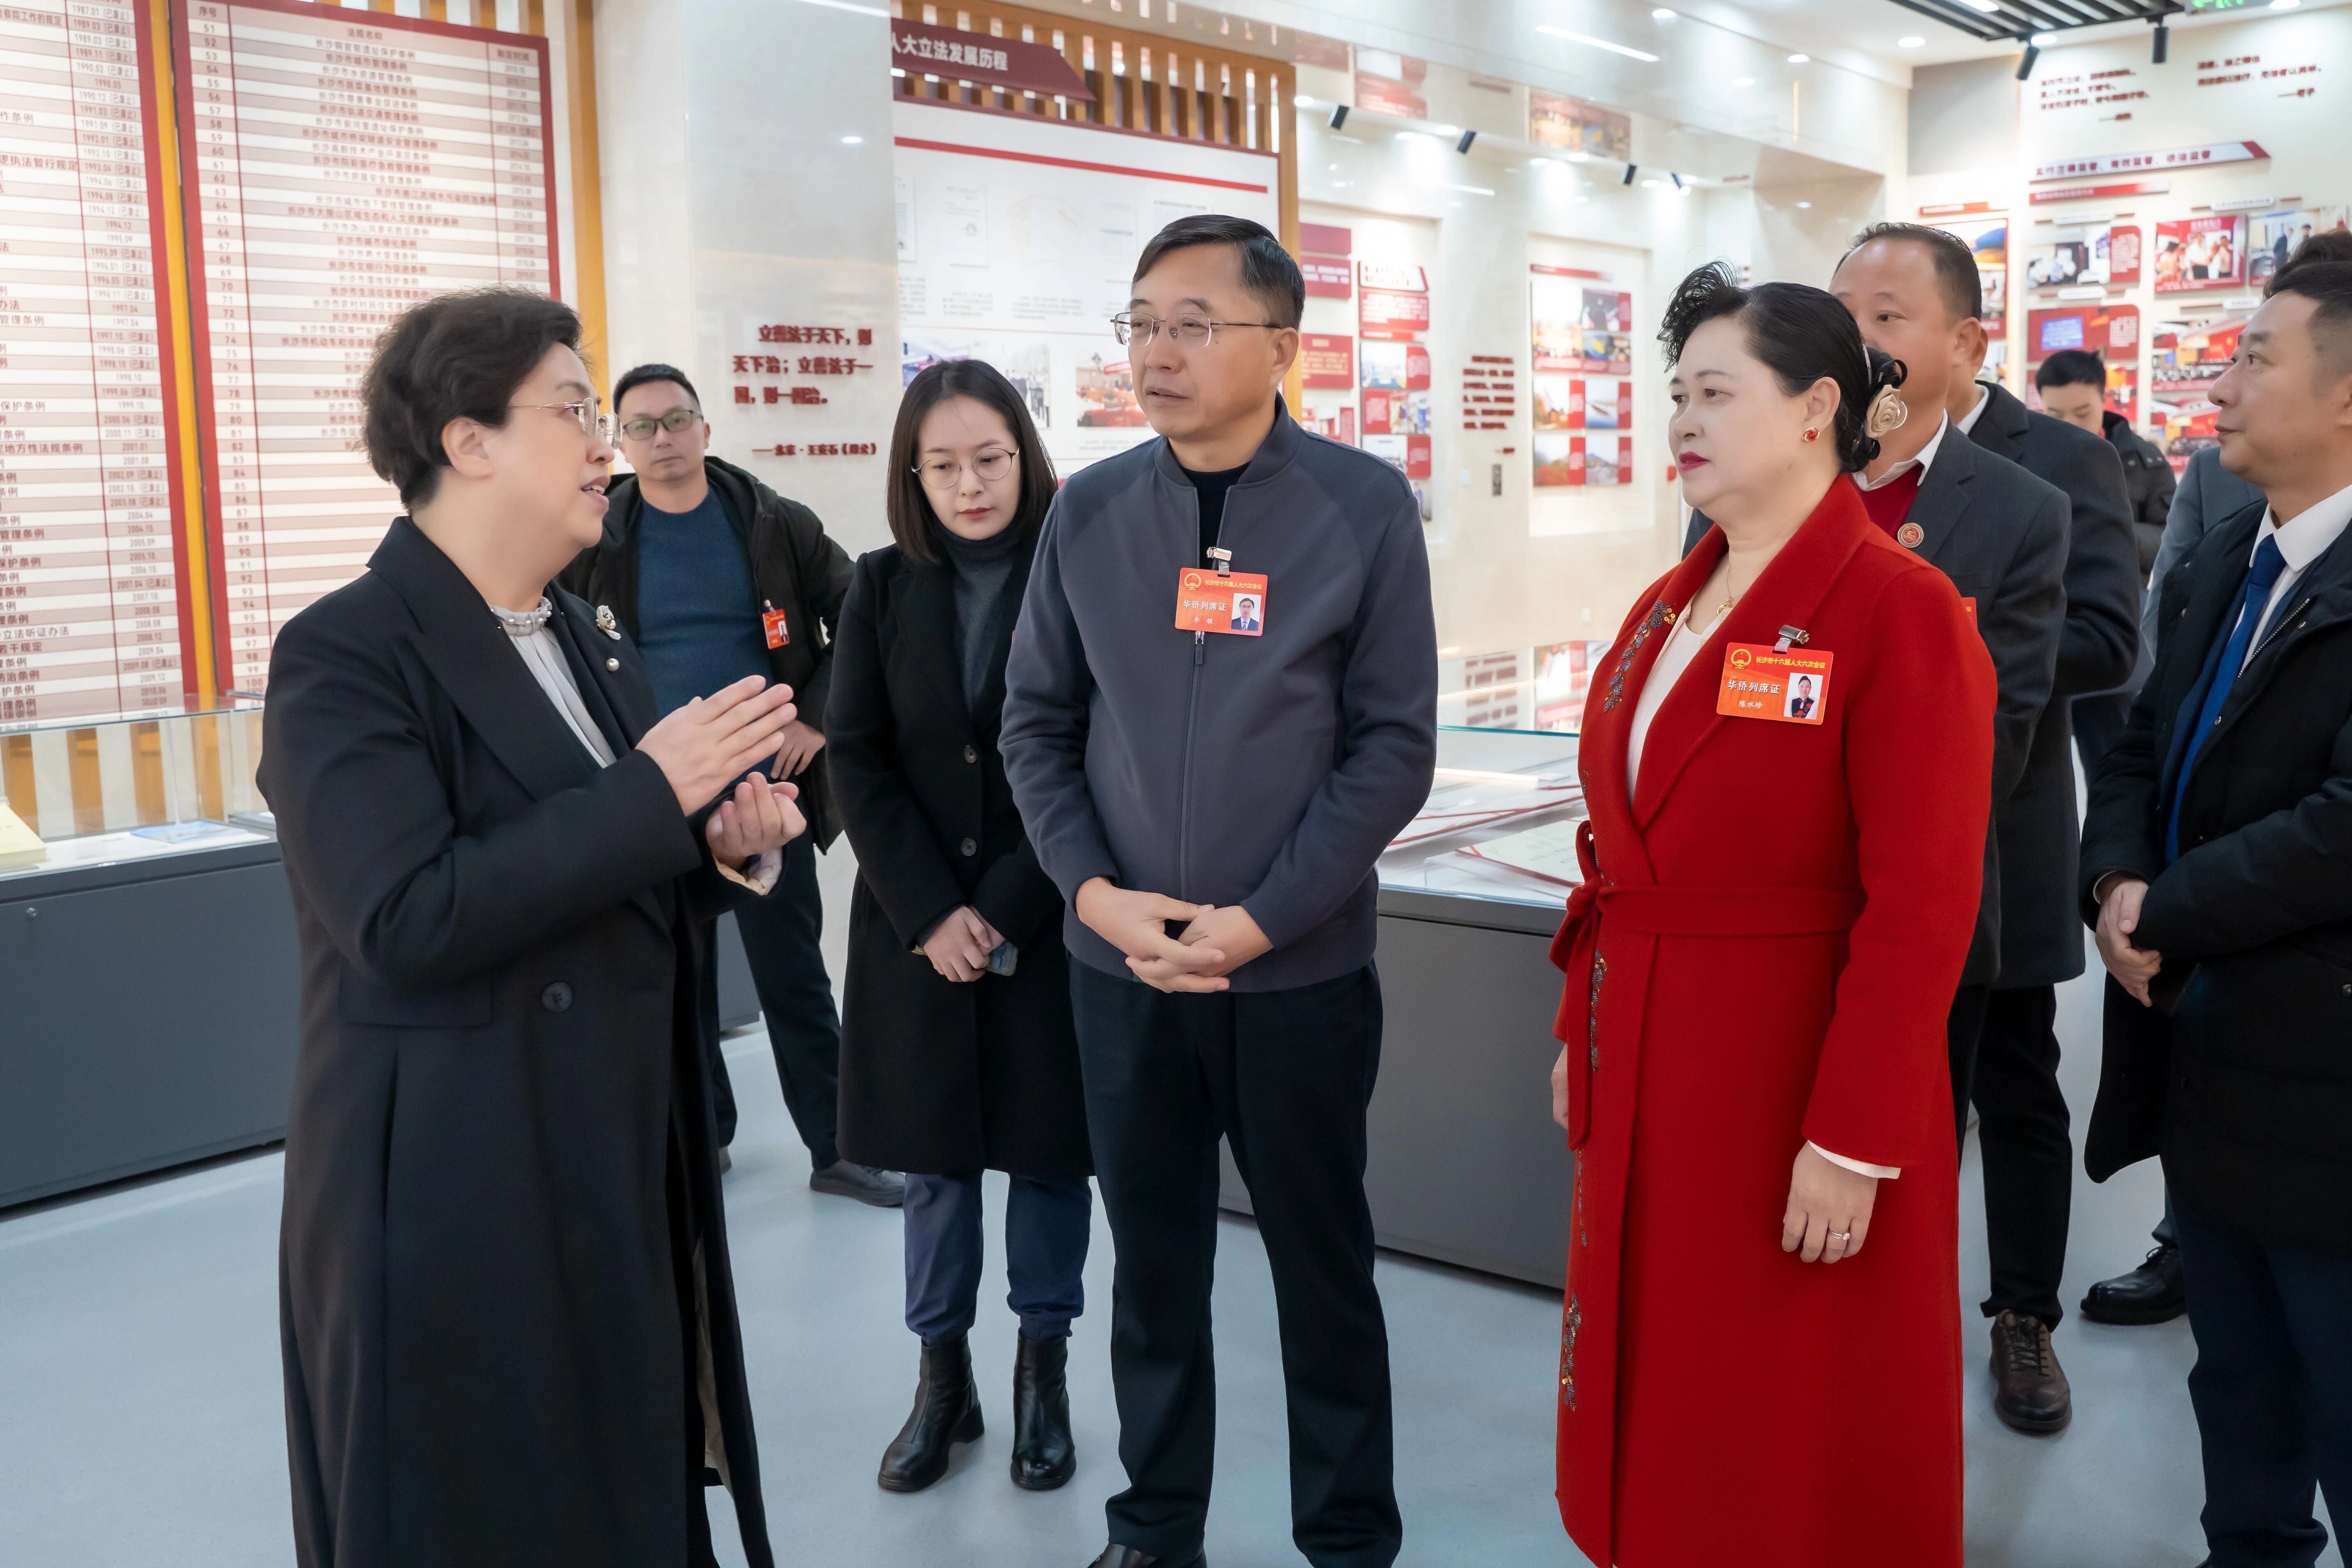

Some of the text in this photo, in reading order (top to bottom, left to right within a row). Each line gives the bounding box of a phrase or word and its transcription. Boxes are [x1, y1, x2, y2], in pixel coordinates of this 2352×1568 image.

[203, 23, 215, 34] 51
[204, 36, 217, 47] 52
[205, 50, 218, 61] 53
[205, 64, 219, 74] 54
[207, 78, 220, 88] 55
[207, 91, 221, 102] 56
[208, 105, 221, 115] 57
[209, 119, 223, 129] 58
[210, 133, 223, 143] 59
[211, 146, 224, 156] 60
[212, 160, 224, 170] 61
[212, 173, 226, 184] 62
[214, 187, 227, 197] 63
[214, 201, 228, 210] 64
[216, 214, 228, 223] 65
[217, 228, 230, 237] 66
[218, 242, 230, 251] 67
[218, 254, 232, 264] 68
[219, 268, 232, 277] 69
[221, 281, 233, 291] 70
[222, 308, 235, 318] 72
[224, 322, 235, 331] 73
[224, 335, 237, 344] 74
[226, 349, 237, 357] 75
[226, 361, 239, 371] 76
[228, 375, 239, 384] 77
[228, 389, 240, 398] 78
[229, 415, 242, 424] 80
[230, 429, 242, 437] 81
[230, 442, 244, 451] 82
[232, 456, 244, 464] 83
[232, 468, 246, 478] 84
[233, 482, 246, 491] 85
[234, 495, 248, 504] 86
[235, 508, 248, 517] 87
[236, 521, 249, 530] 88
[237, 534, 250, 543] 89
[237, 547, 251, 557] 90
[239, 561, 251, 569] 91
[240, 574, 253, 583] 92
[1205, 579, 1262, 590] 长沙市十六届人大六次会议
[241, 587, 254, 596] 93
[242, 600, 255, 609] 94
[1183, 599, 1227, 612] 华侨列席证
[243, 613, 256, 622] 95
[243, 626, 257, 635] 96
[245, 639, 257, 648] 97
[245, 652, 259, 661] 98
[1756, 656, 1826, 669] 长沙市十六届人大六次会议
[1727, 680, 1781, 694] 华侨列席证
[1738, 700, 1763, 709] 陈水珍
